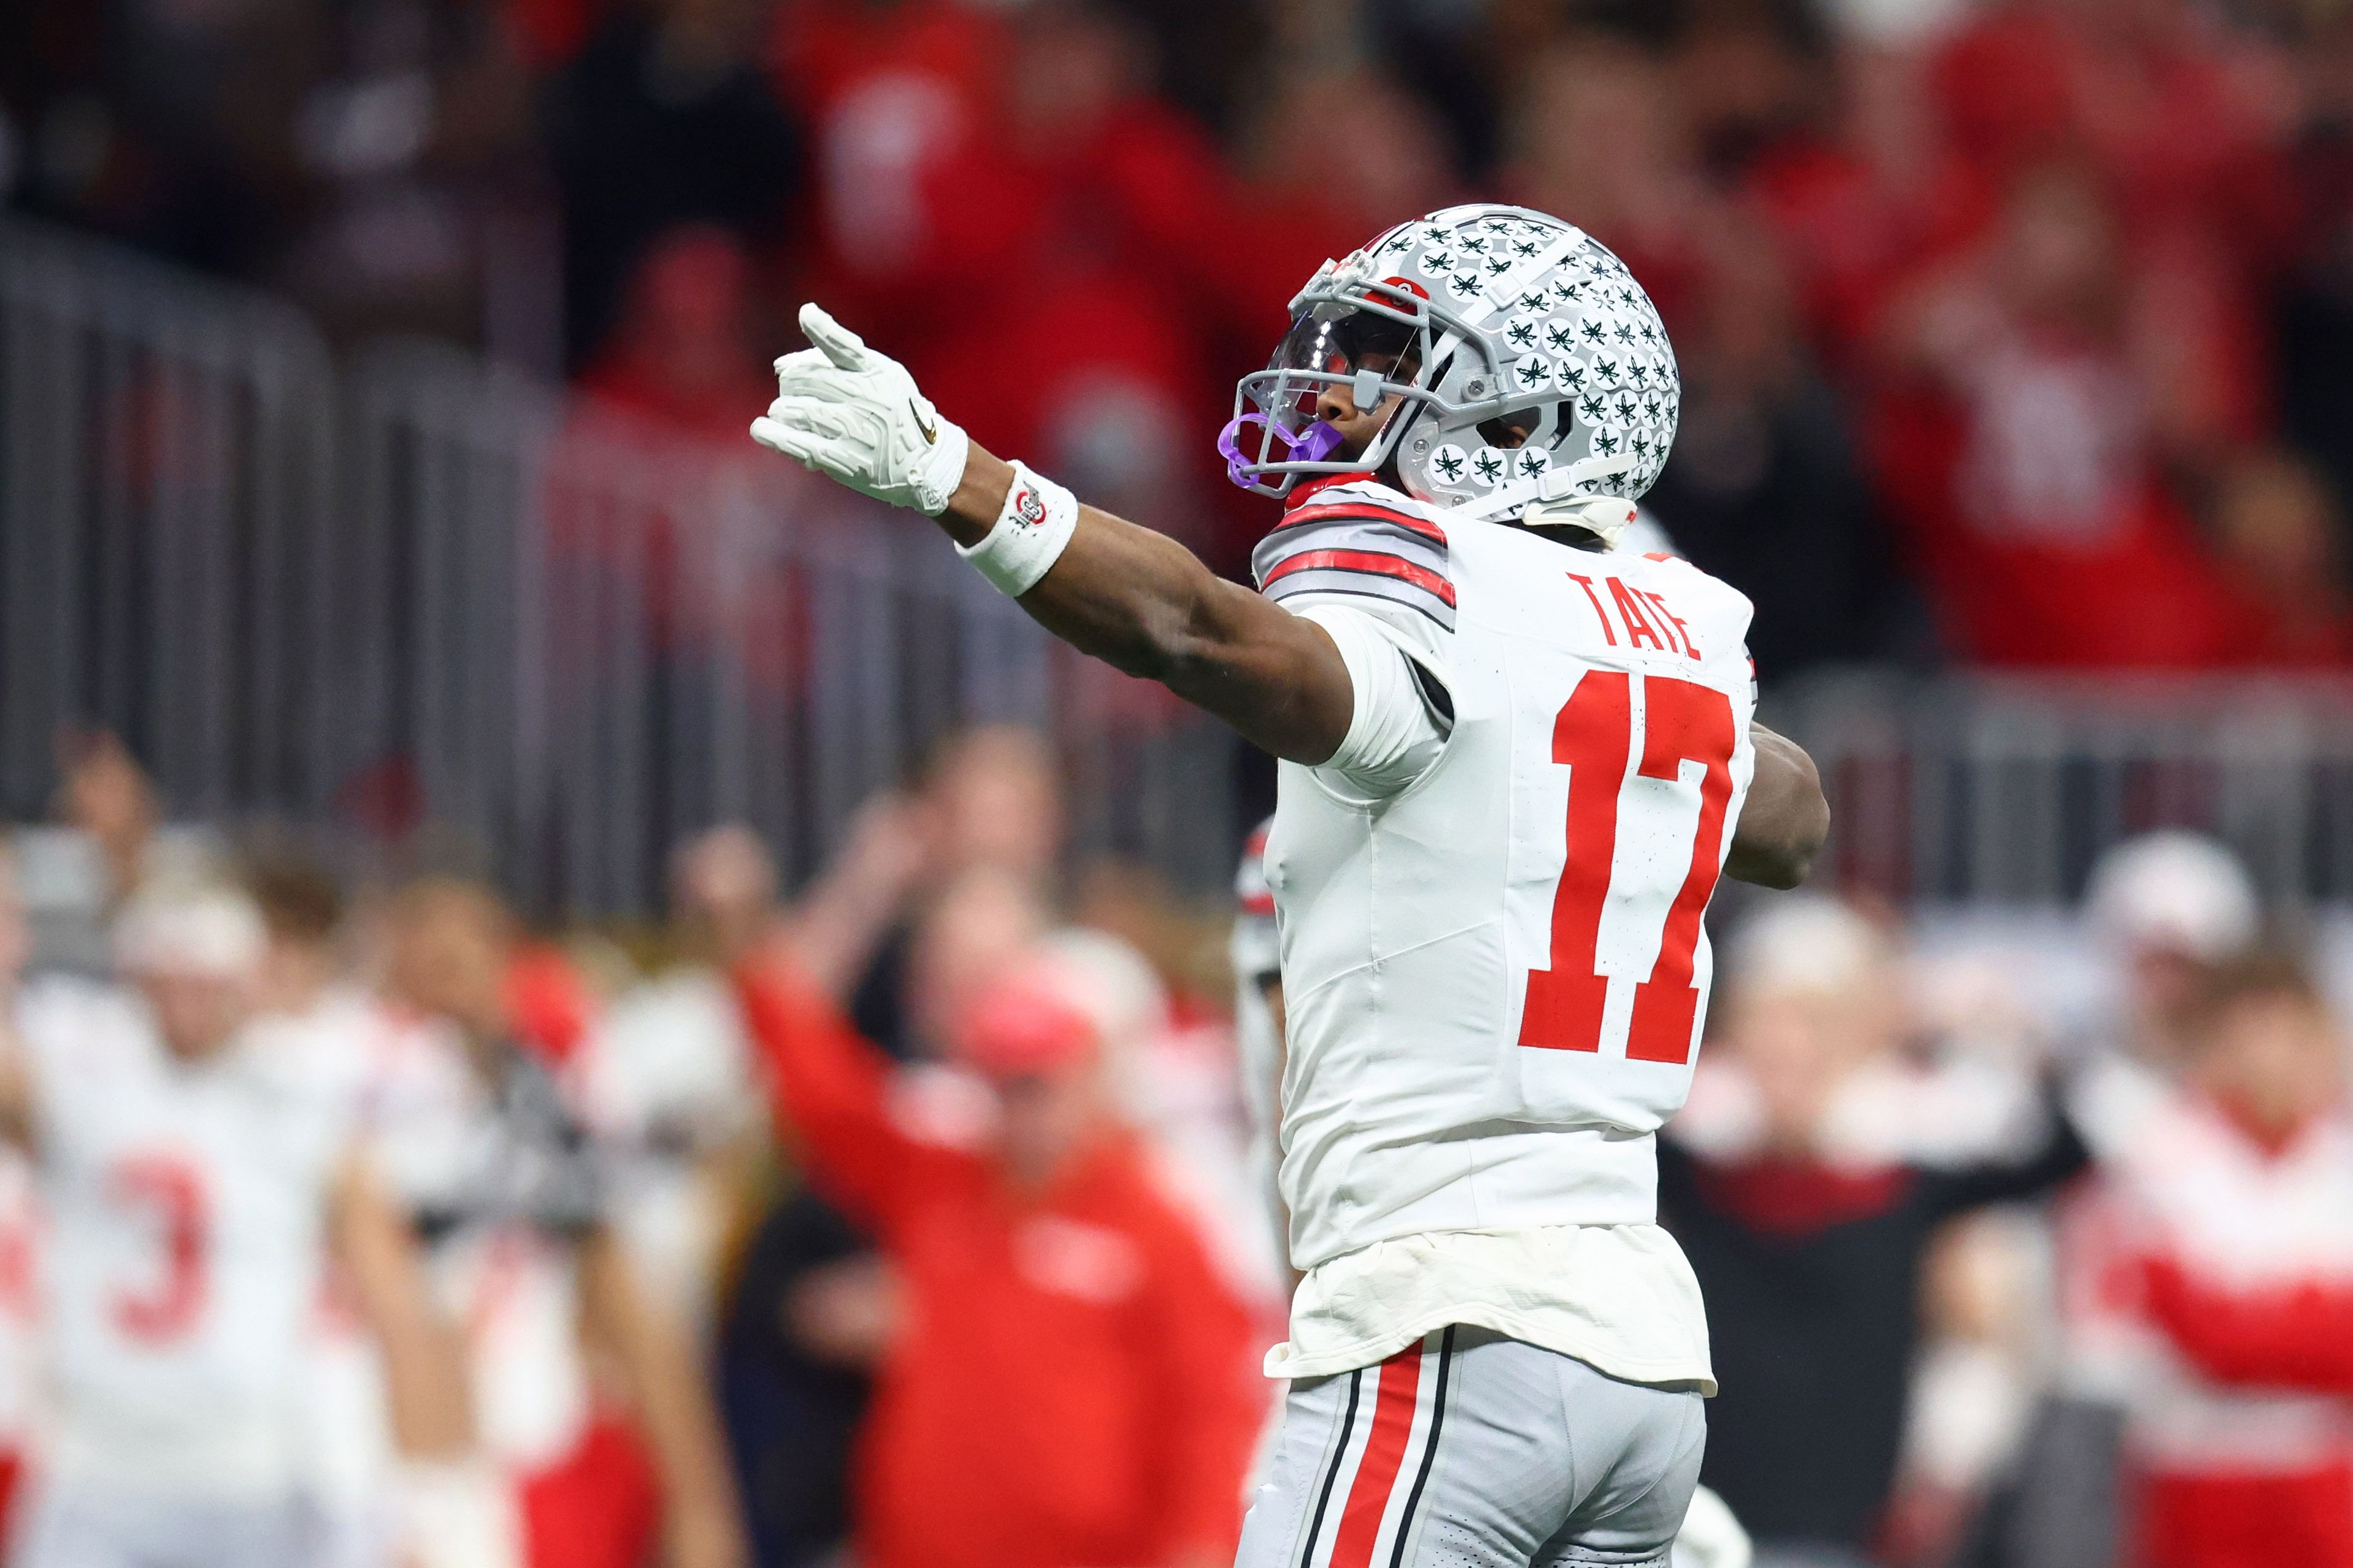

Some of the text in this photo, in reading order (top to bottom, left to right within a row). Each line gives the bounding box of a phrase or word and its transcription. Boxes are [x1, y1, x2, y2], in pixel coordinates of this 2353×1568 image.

[1567, 572, 1701, 661] TATE
[1517, 669, 1735, 1065] 17
[107, 1151, 211, 1343] 3
